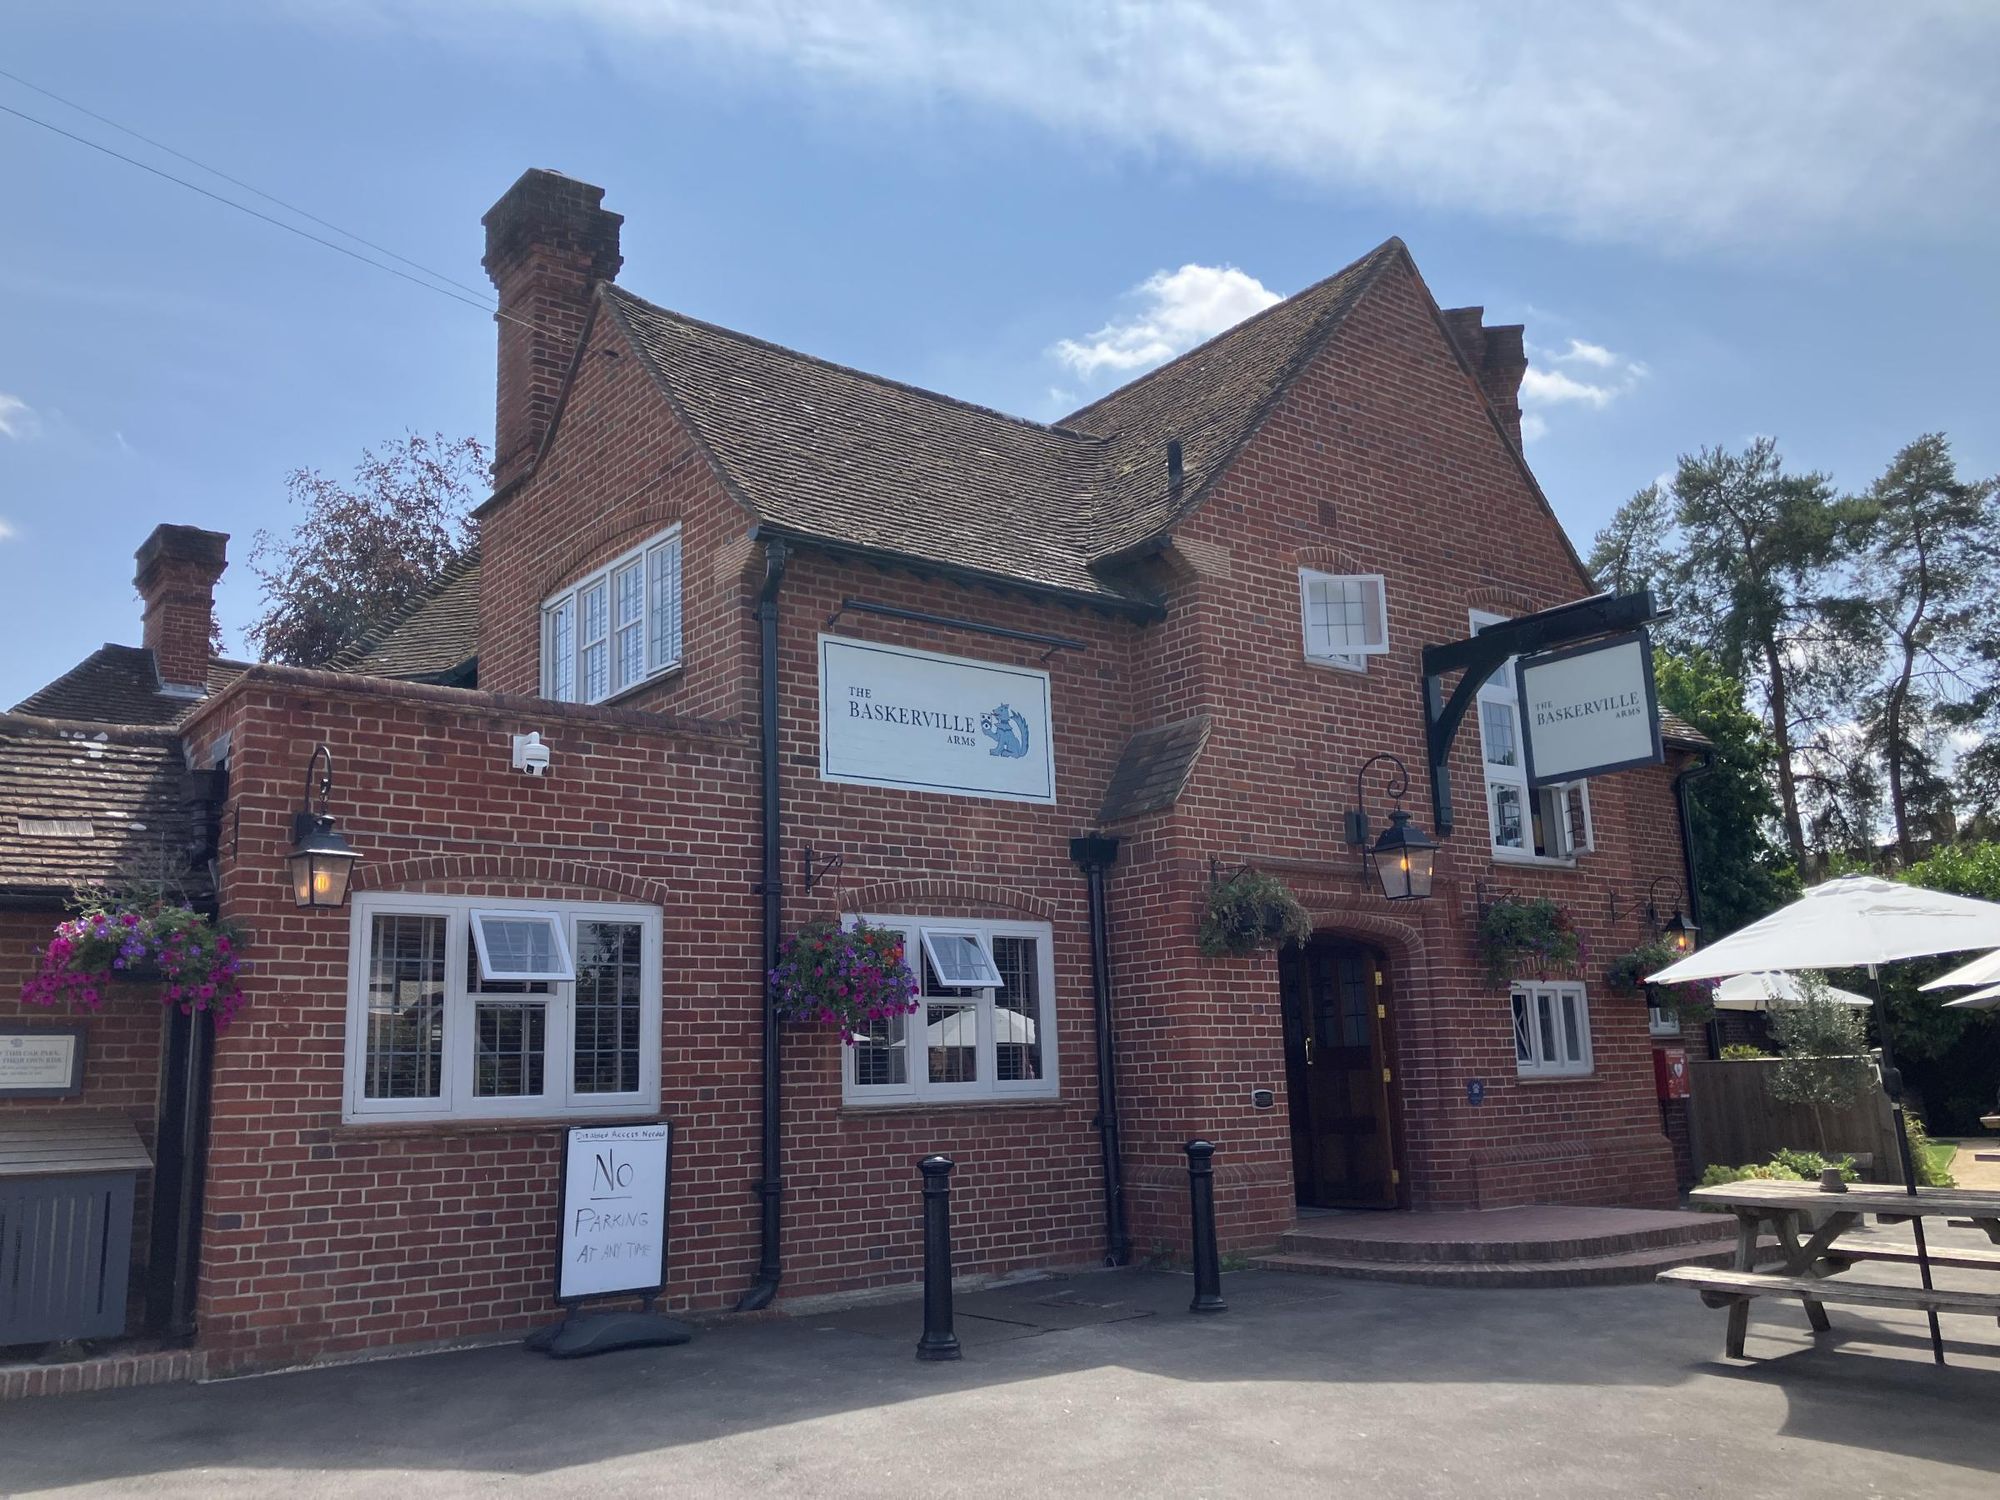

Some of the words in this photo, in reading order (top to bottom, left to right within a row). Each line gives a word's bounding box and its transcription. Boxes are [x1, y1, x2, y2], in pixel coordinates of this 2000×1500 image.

[849, 686, 872, 699] THE
[1536, 700, 1553, 711] THE
[1537, 691, 1639, 726] BASKERVILLE
[849, 701, 975, 733] BASKERVILLE
[1615, 707, 1641, 719] ARMS
[947, 735, 976, 747] ARMS
[612, 1131, 639, 1139] Access
[575, 1207, 649, 1237] PARKING
[576, 1244, 598, 1263] AT
[601, 1242, 622, 1261] ANY
[627, 1241, 652, 1258] TIME
